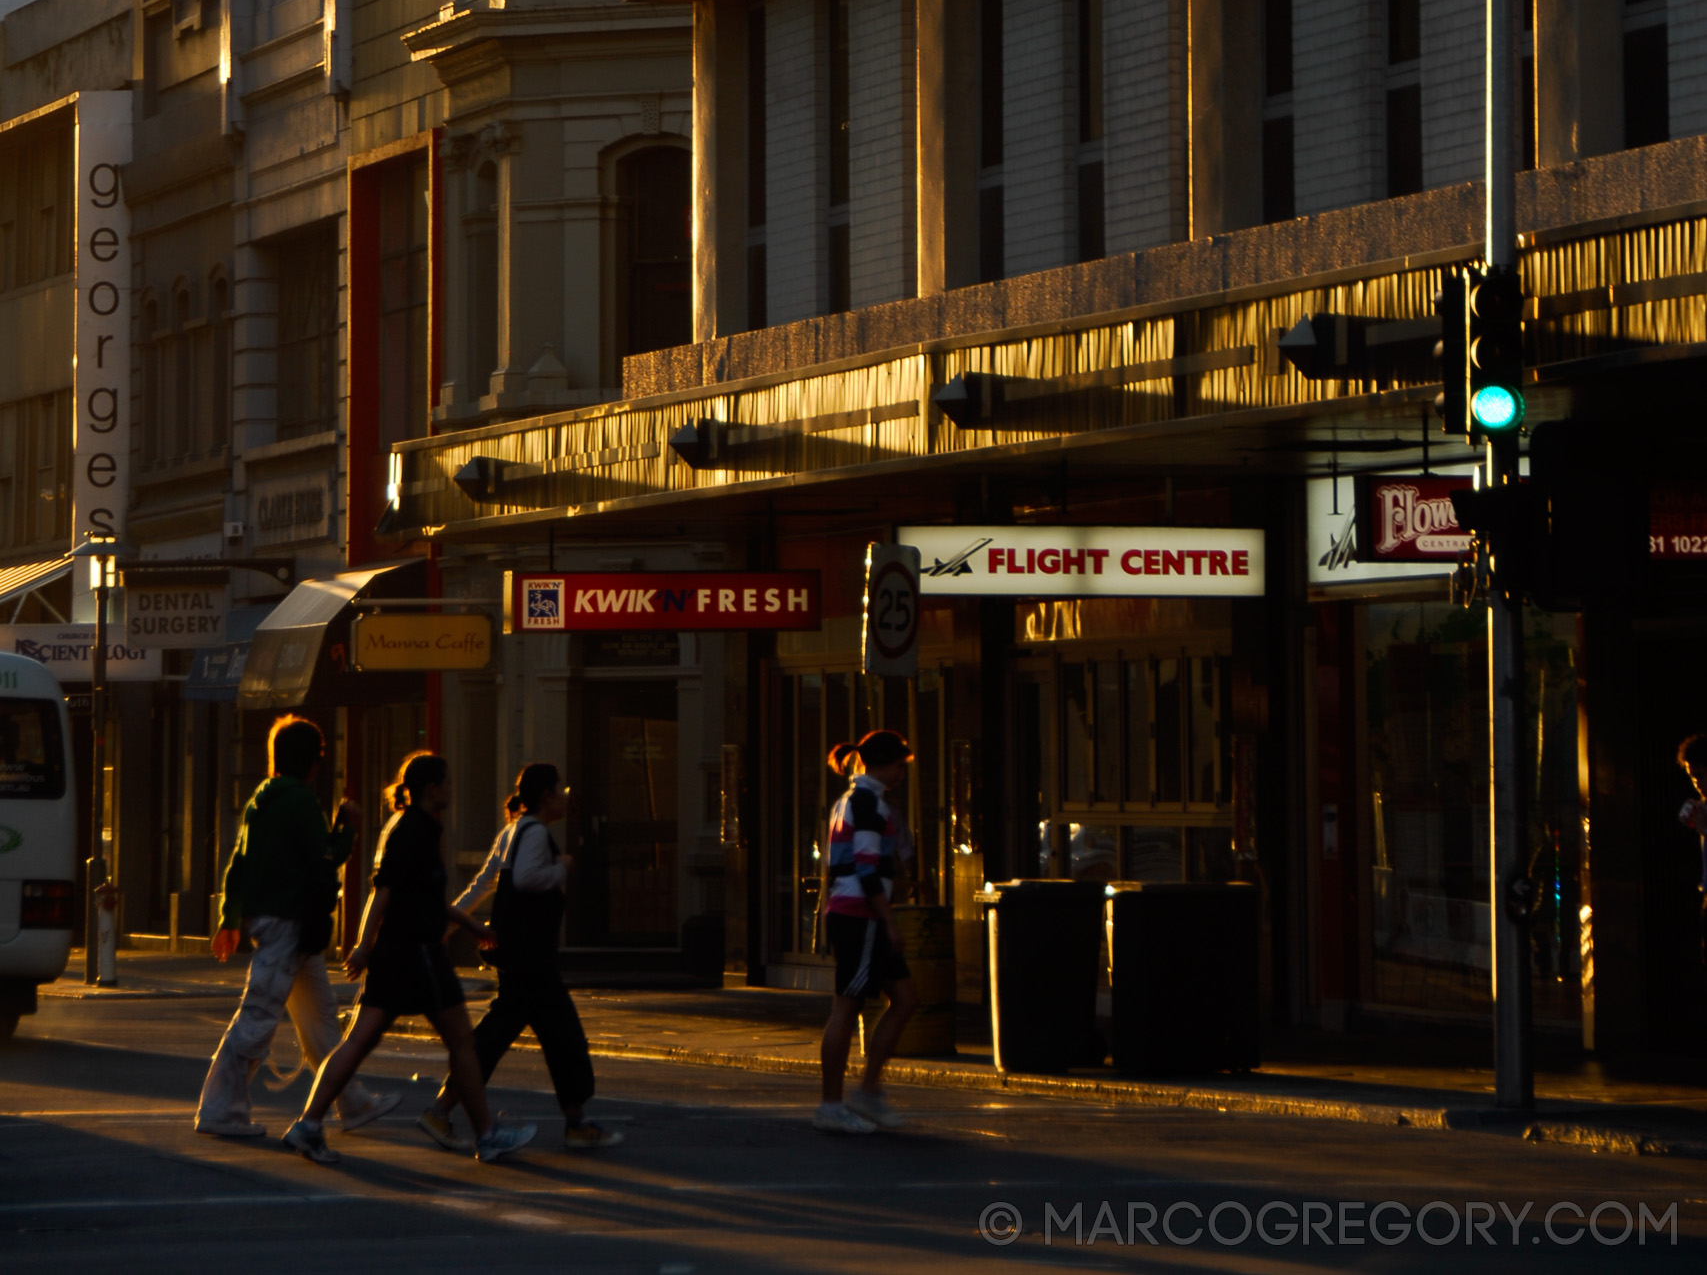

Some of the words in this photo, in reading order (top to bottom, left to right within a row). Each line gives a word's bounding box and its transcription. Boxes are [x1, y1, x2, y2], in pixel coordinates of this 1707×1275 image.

[88, 162, 119, 533] georges
[1422, 540, 1469, 548] CENTRA
[988, 548, 1109, 575] FLIGHT
[1121, 549, 1249, 576] CENTRE
[138, 591, 214, 611] DENTAL
[573, 588, 658, 614] KWIK
[697, 588, 809, 613] FRESH
[878, 589, 911, 631] 25
[131, 613, 222, 635] SURGERY
[527, 617, 560, 626] FRESH
[17, 638, 147, 664] SCIENTLOGY
[365, 633, 430, 651] Manna
[434, 631, 486, 654] Caffe
[0, 670, 18, 689] 11
